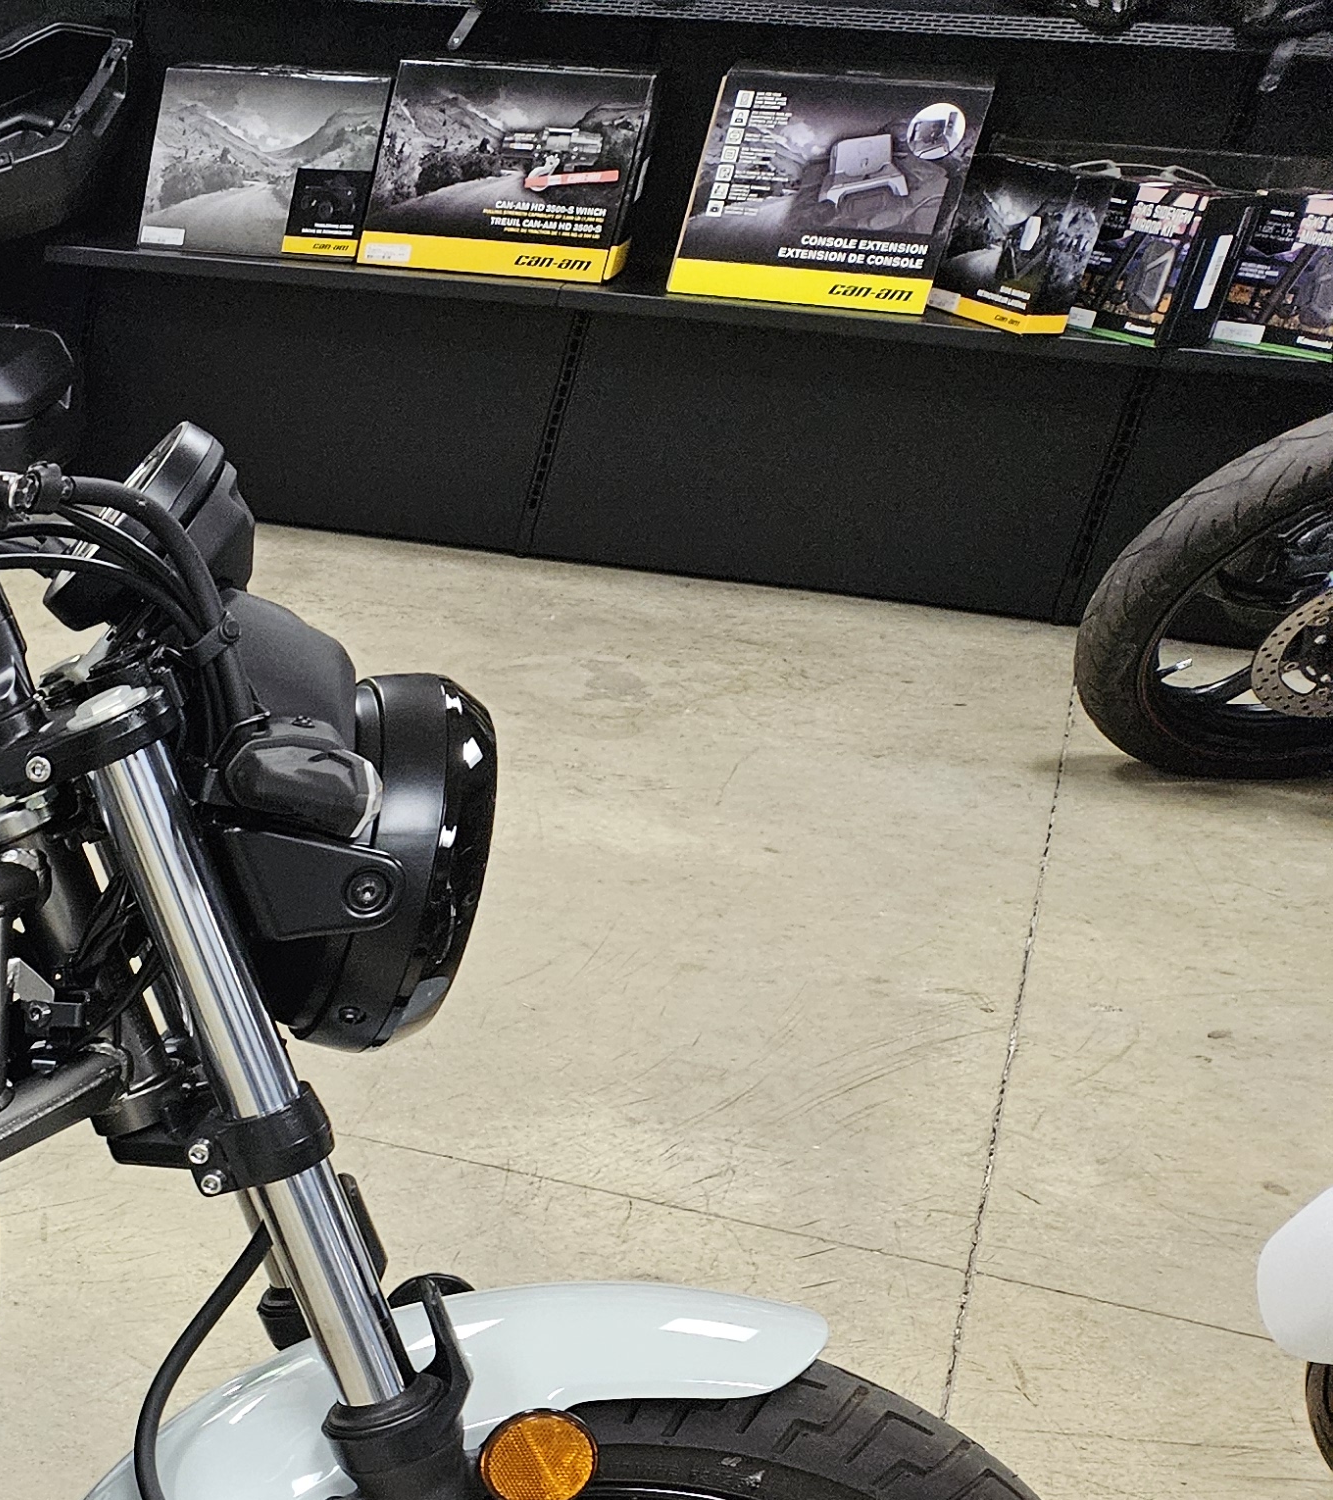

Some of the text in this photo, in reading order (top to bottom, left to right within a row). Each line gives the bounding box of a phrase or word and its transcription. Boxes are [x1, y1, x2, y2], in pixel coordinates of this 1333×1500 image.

[495, 200, 607, 217] CAN-AM HD 3500-S WINCH
[490, 216, 603, 233] TREUIL CAN-AM HD 3500-S
[801, 234, 928, 255] CONSOLE EXTENSION
[514, 254, 593, 272] can-am
[778, 247, 924, 270] EXTENSION DE CONSOLE
[828, 283, 914, 302] can-am
